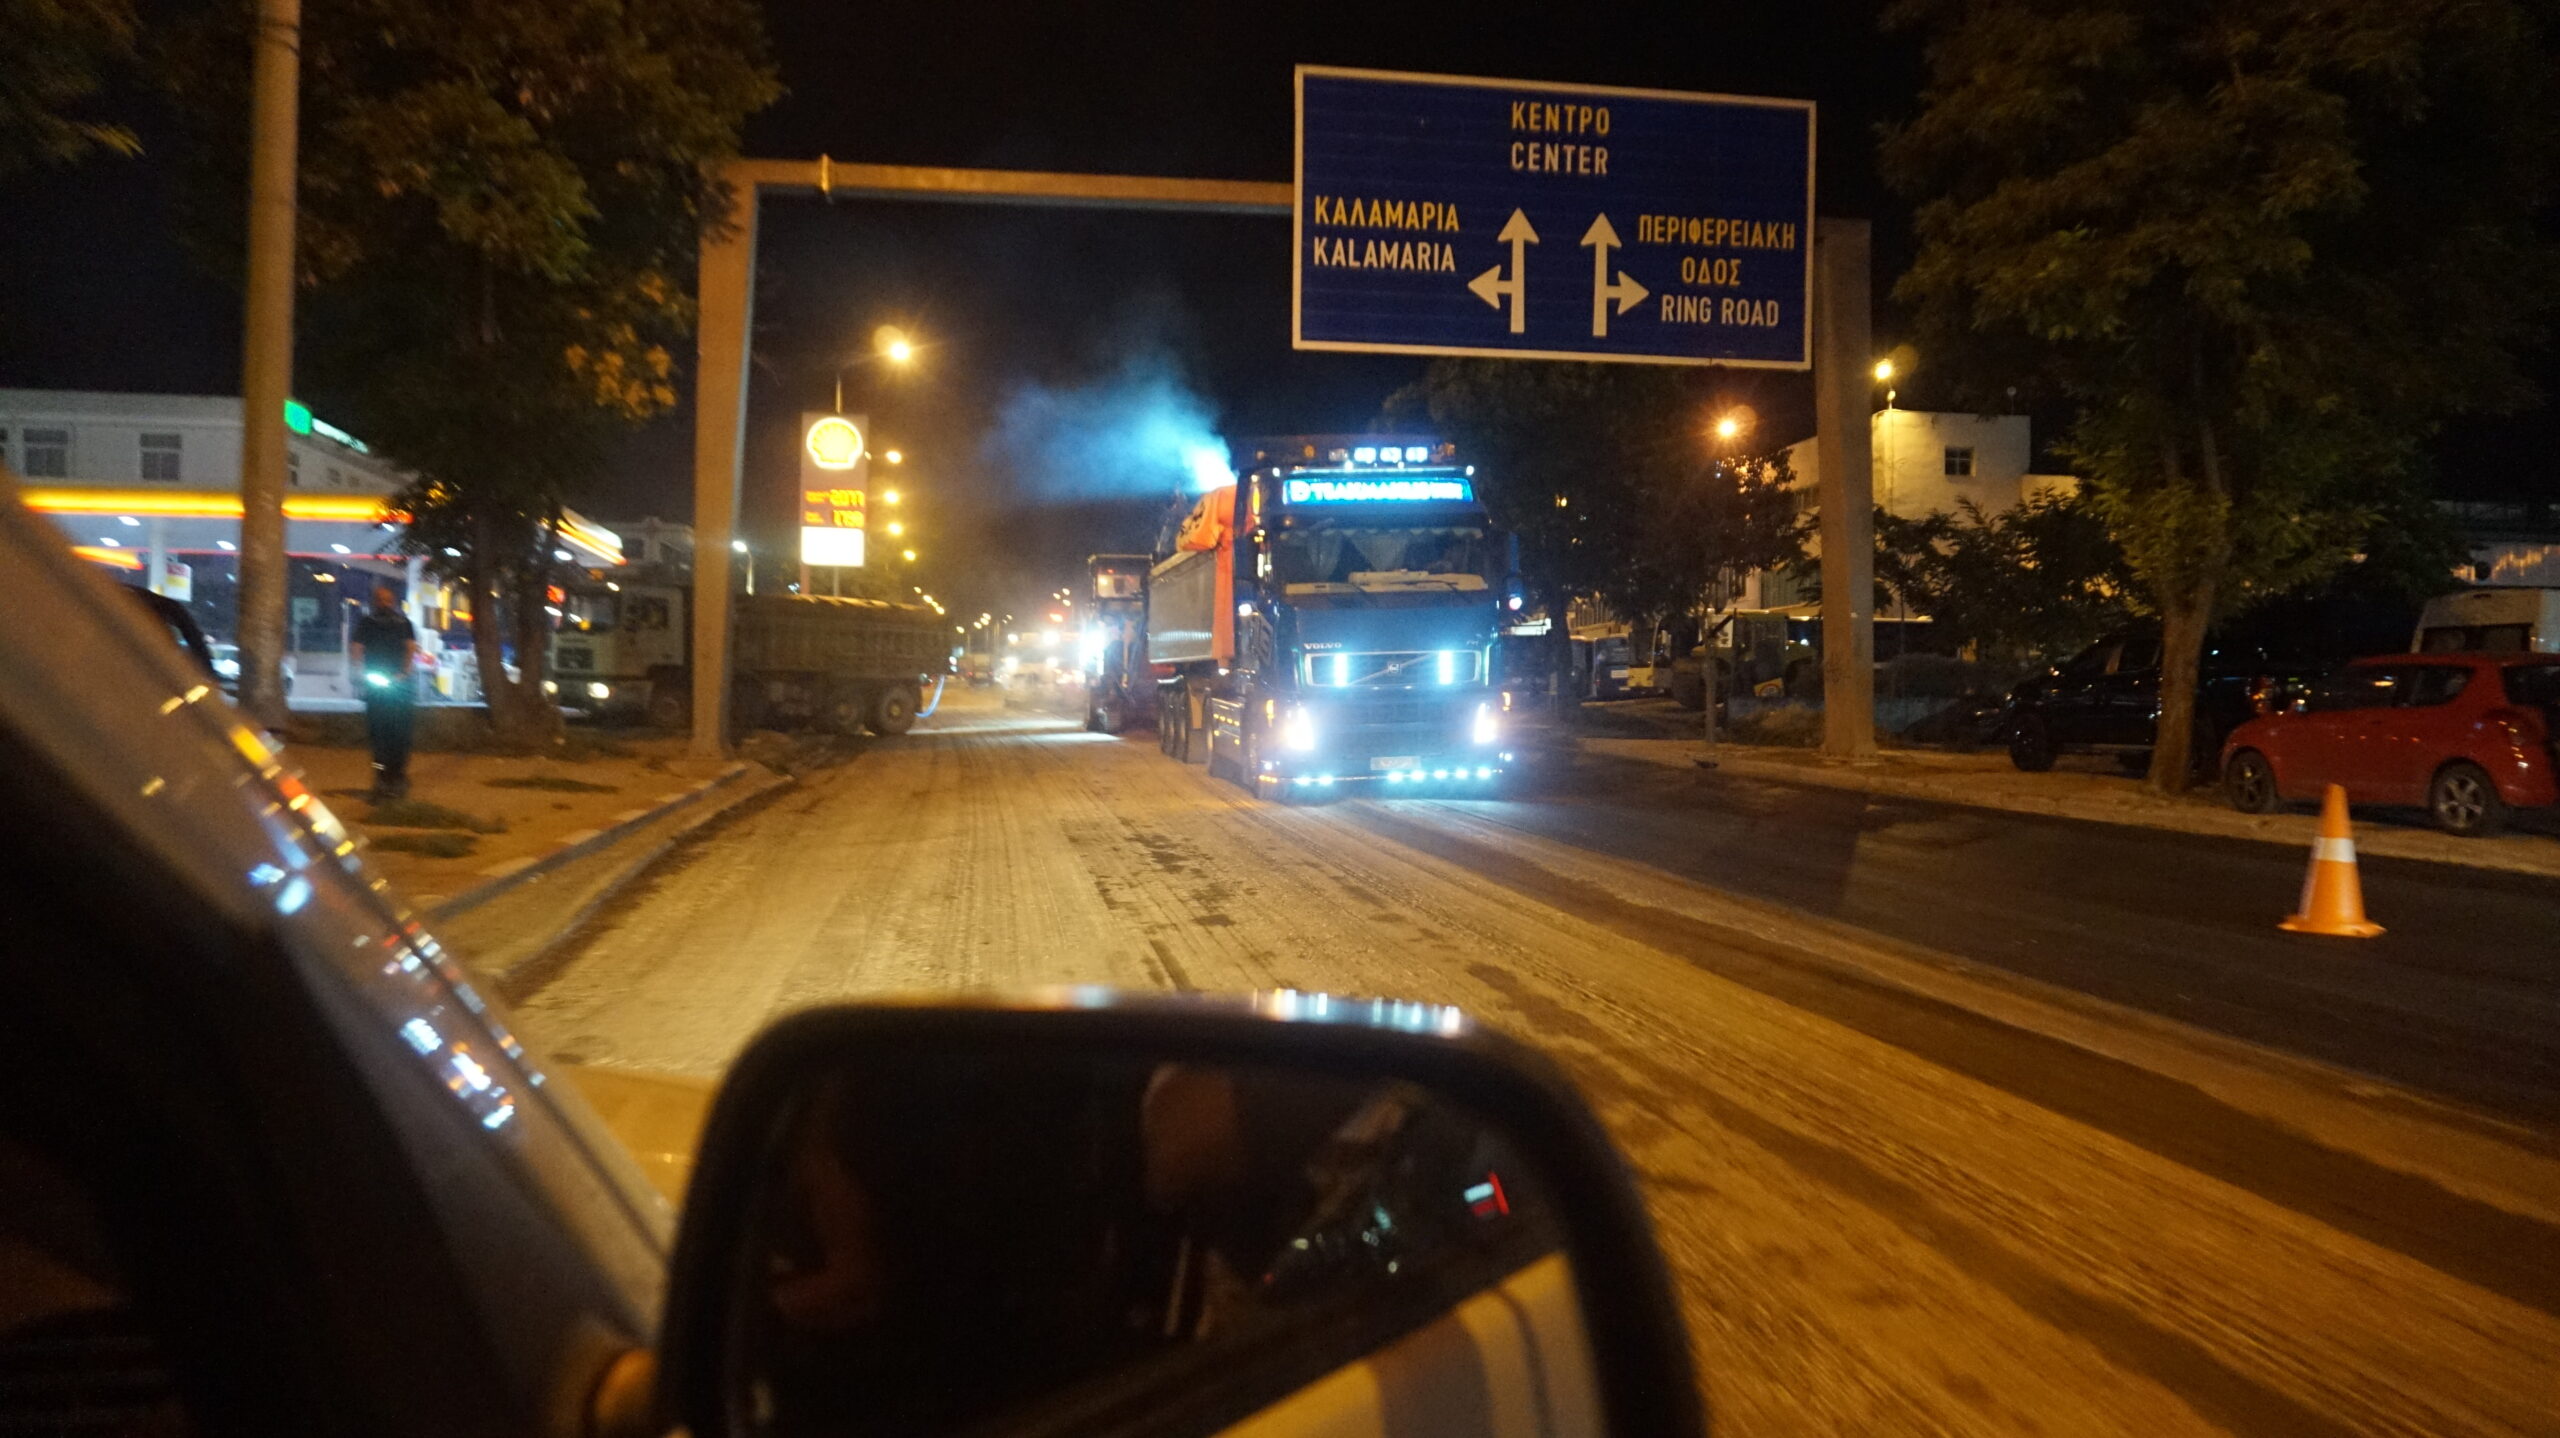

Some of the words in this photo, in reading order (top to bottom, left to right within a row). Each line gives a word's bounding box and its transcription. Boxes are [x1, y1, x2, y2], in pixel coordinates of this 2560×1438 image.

[1511, 101, 1610, 136] ΚΕΝΤΡΟ
[1511, 142, 1609, 175] CENTER
[1314, 194, 1460, 232] ΚΑΛΑΜΑΡΙΑ
[1638, 213, 1796, 249] ΠΕΡΙΦΕΡΕΙΑΚΗ
[1313, 236, 1456, 272] KALAMARIA
[1681, 256, 1742, 286] ΟΔΟΣ
[1661, 294, 1712, 324] RING
[1721, 297, 1779, 327] ROAD
[1304, 642, 1342, 650] VOLVO
